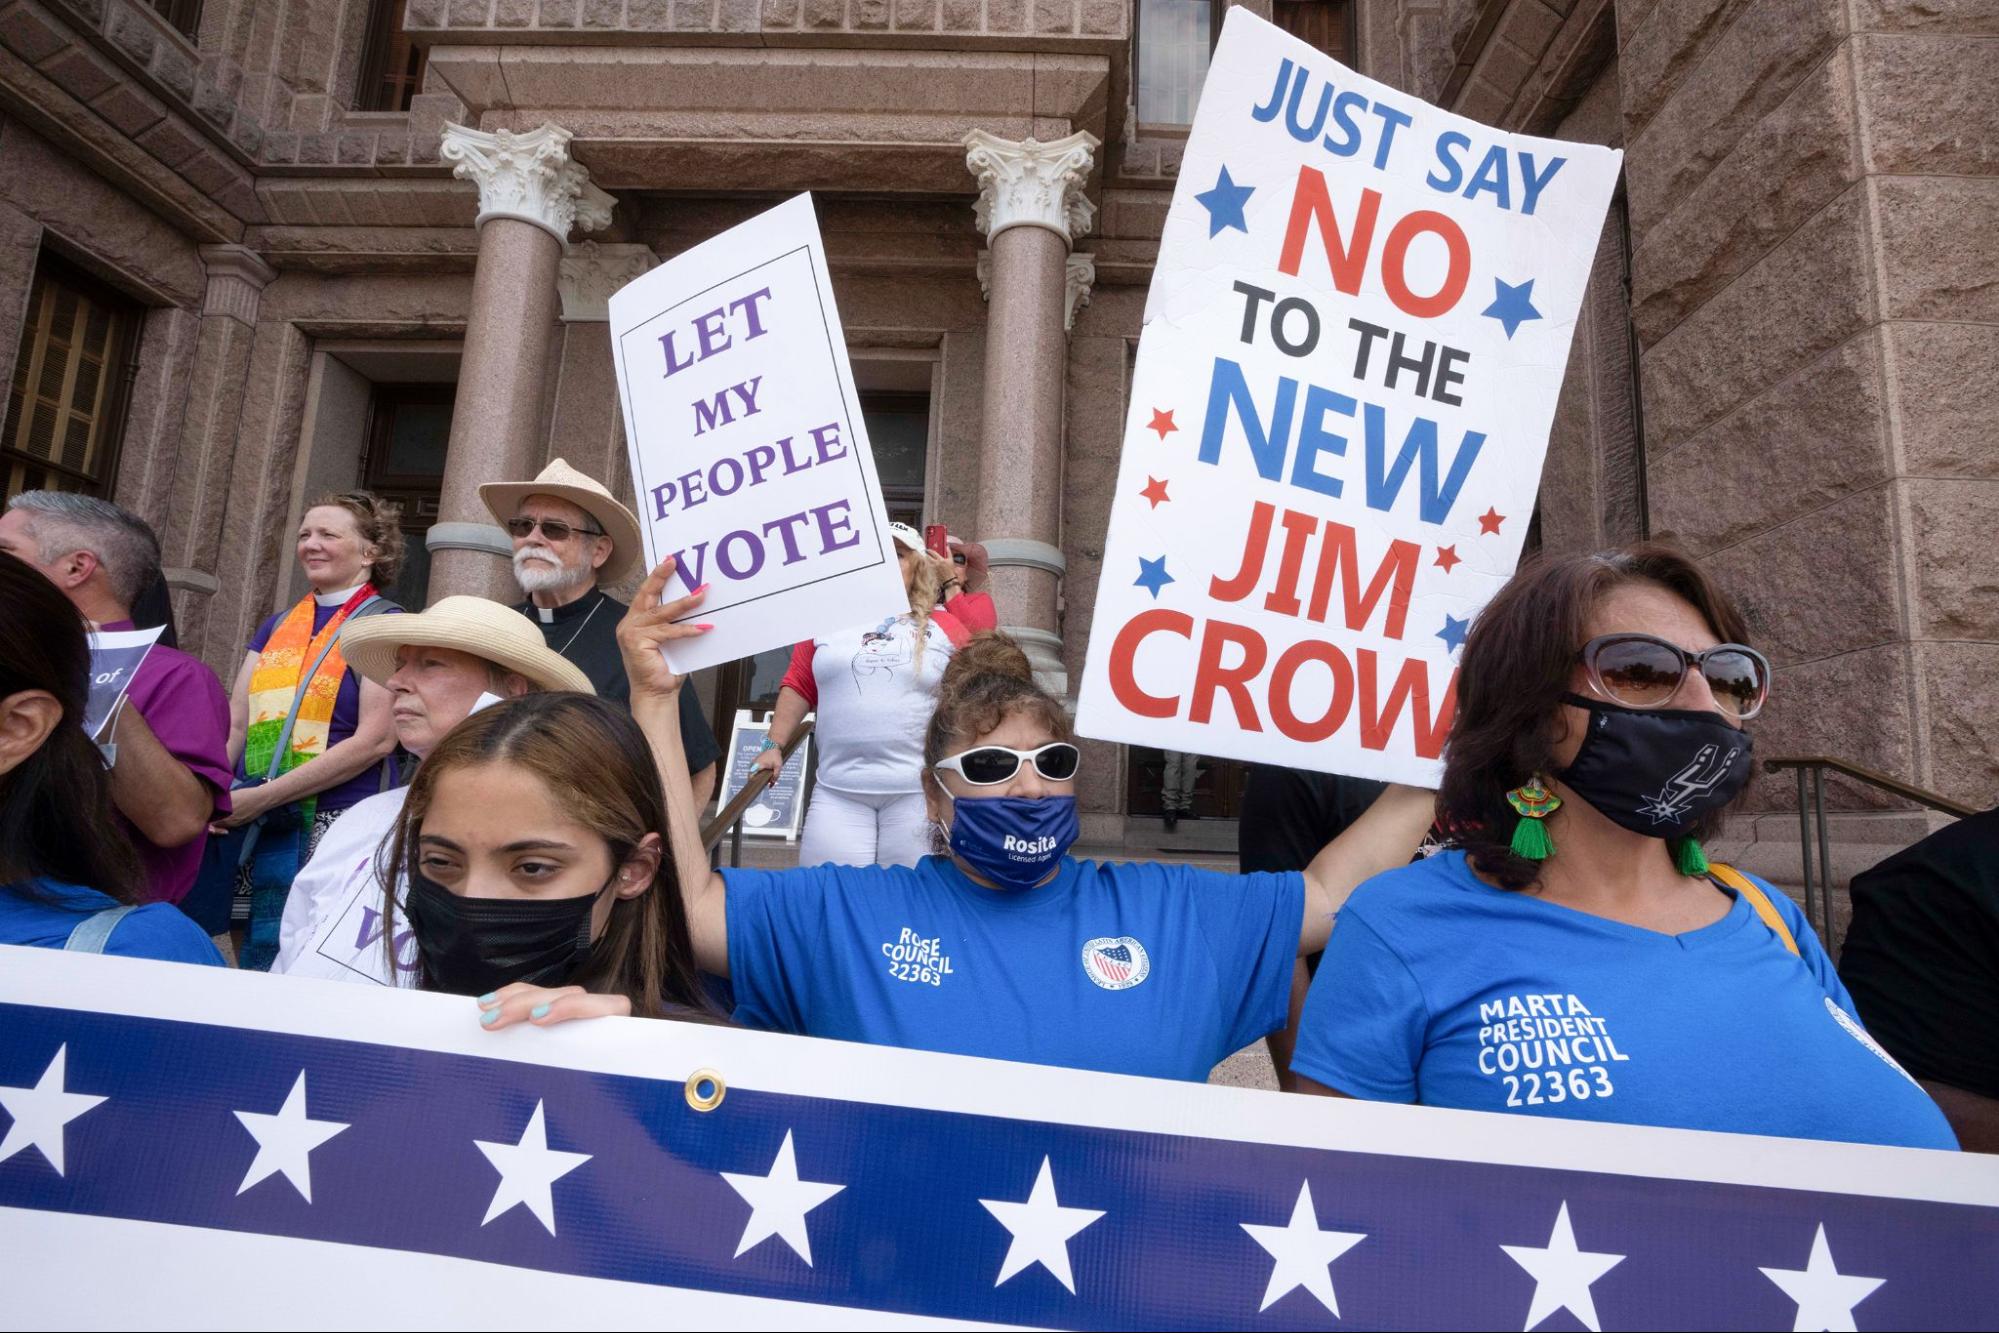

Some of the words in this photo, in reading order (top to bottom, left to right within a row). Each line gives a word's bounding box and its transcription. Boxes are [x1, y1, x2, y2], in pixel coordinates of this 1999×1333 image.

[1251, 57, 1412, 171] JUST
[1426, 130, 1568, 216] SAY
[1277, 164, 1471, 318] NO
[658, 286, 772, 378] LET
[1233, 280, 1321, 358] TO
[1348, 317, 1471, 407] THE
[691, 375, 763, 437] MY
[1198, 356, 1487, 526] NEW
[650, 422, 848, 521] PEOPLE
[671, 498, 861, 596] VOTE
[1208, 500, 1422, 641] JIM
[95, 667, 124, 684] of
[1108, 608, 1462, 760] CROW
[1003, 834, 1057, 854] Rosita
[1008, 852, 1036, 863] Licensed
[882, 943, 954, 973] COUNCIL
[899, 927, 940, 956] ROSE
[888, 961, 941, 986] 22363
[1479, 1017, 1608, 1046] PRESIDENT
[1480, 994, 1592, 1025] MARTA
[1478, 1036, 1631, 1075] COUNCIL
[1503, 1066, 1614, 1107] 22363
